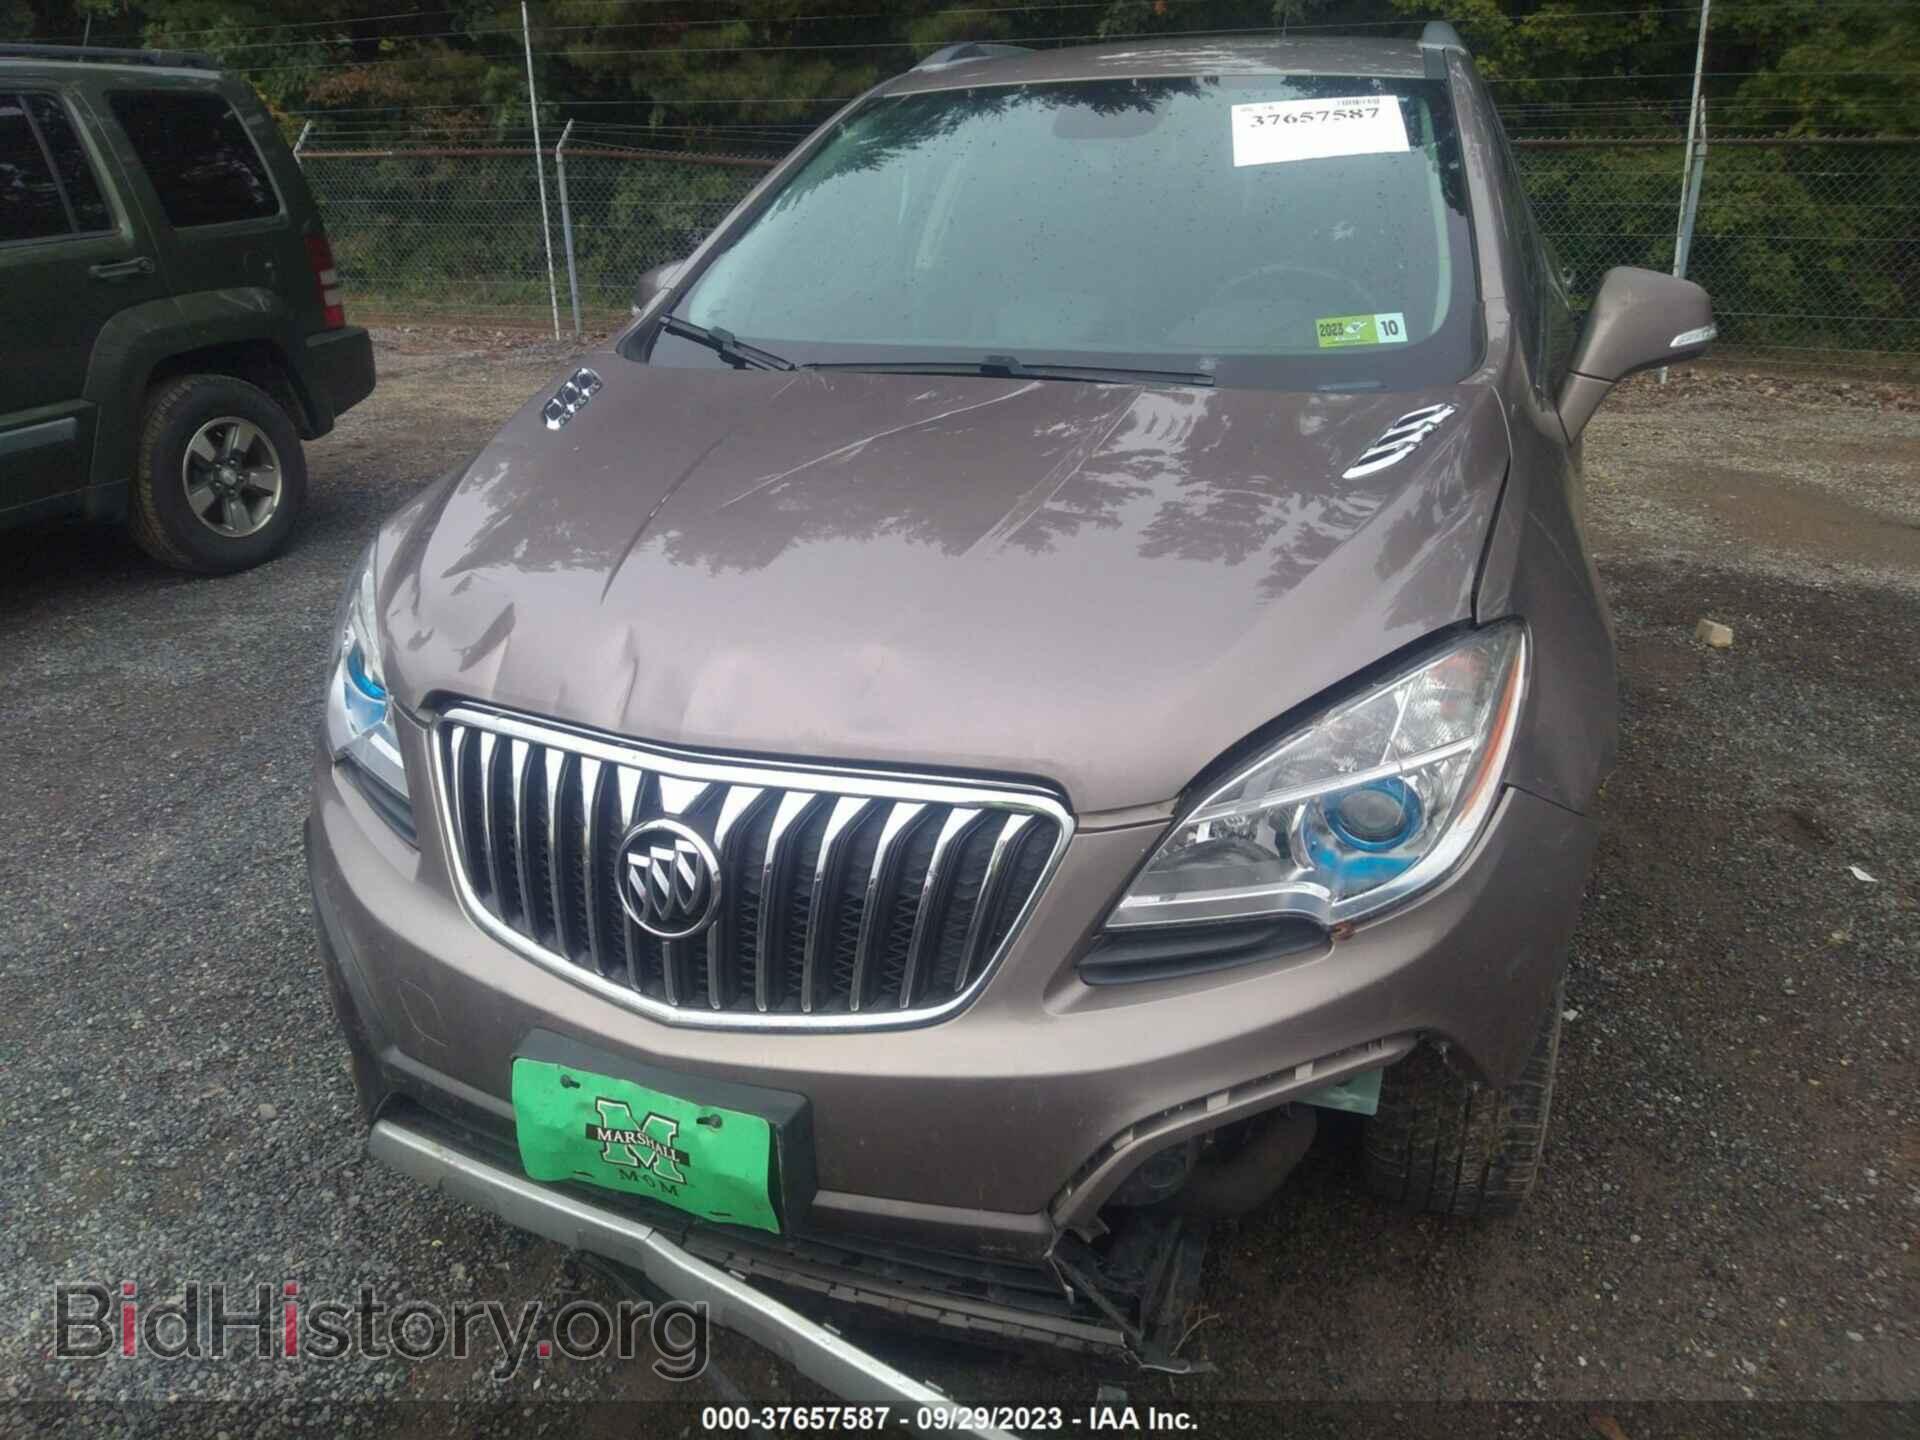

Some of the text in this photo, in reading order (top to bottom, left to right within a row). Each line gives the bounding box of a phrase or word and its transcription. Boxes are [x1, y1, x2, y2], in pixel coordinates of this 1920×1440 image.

[1250, 107, 1380, 128] 37657587
[1319, 320, 1399, 337] 2023 10
[597, 1127, 680, 1162] MARSHALL
[619, 1168, 678, 1196] MOM
